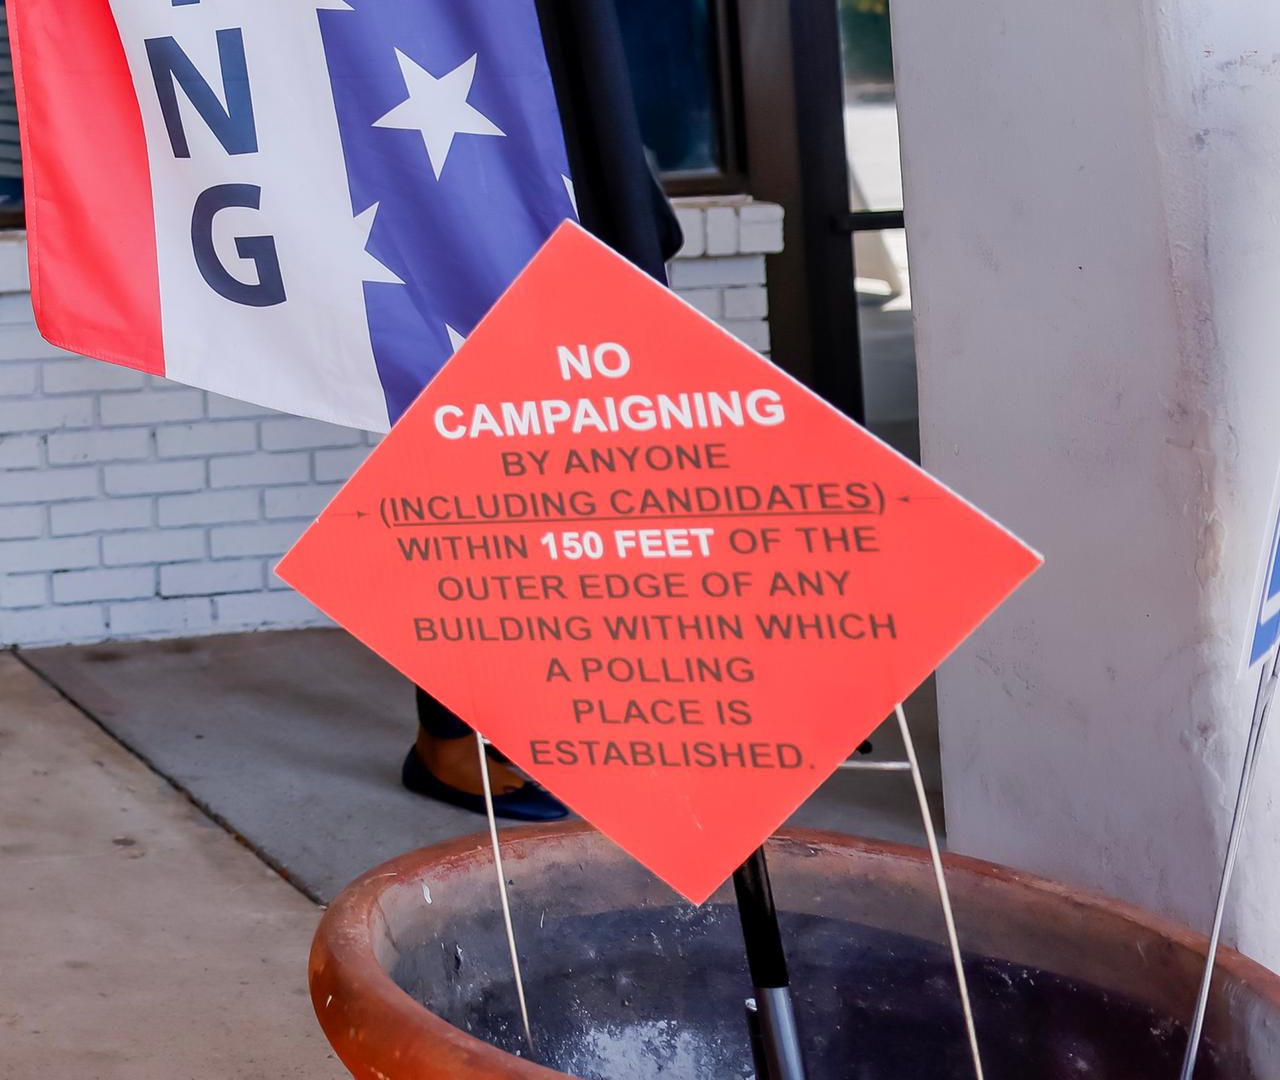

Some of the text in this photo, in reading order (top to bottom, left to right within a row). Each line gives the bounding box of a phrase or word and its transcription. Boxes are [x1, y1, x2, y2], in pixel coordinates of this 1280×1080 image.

[556, 342, 631, 381] NO
[434, 389, 785, 439] CAMPAIGNING
[501, 443, 729, 477] BY ANYONE
[379, 482, 885, 527] (INCLUDING CANDIDATES)
[397, 526, 878, 561] WITHIN 150 FEET OF THE
[437, 571, 849, 601] OUTER EDGE OF ANY
[414, 613, 897, 642] BUILDING WITHIN WHICH
[546, 657, 755, 683] A POLLING
[572, 699, 753, 726] PLACE IS
[530, 740, 816, 770] ESTABLISHED.
